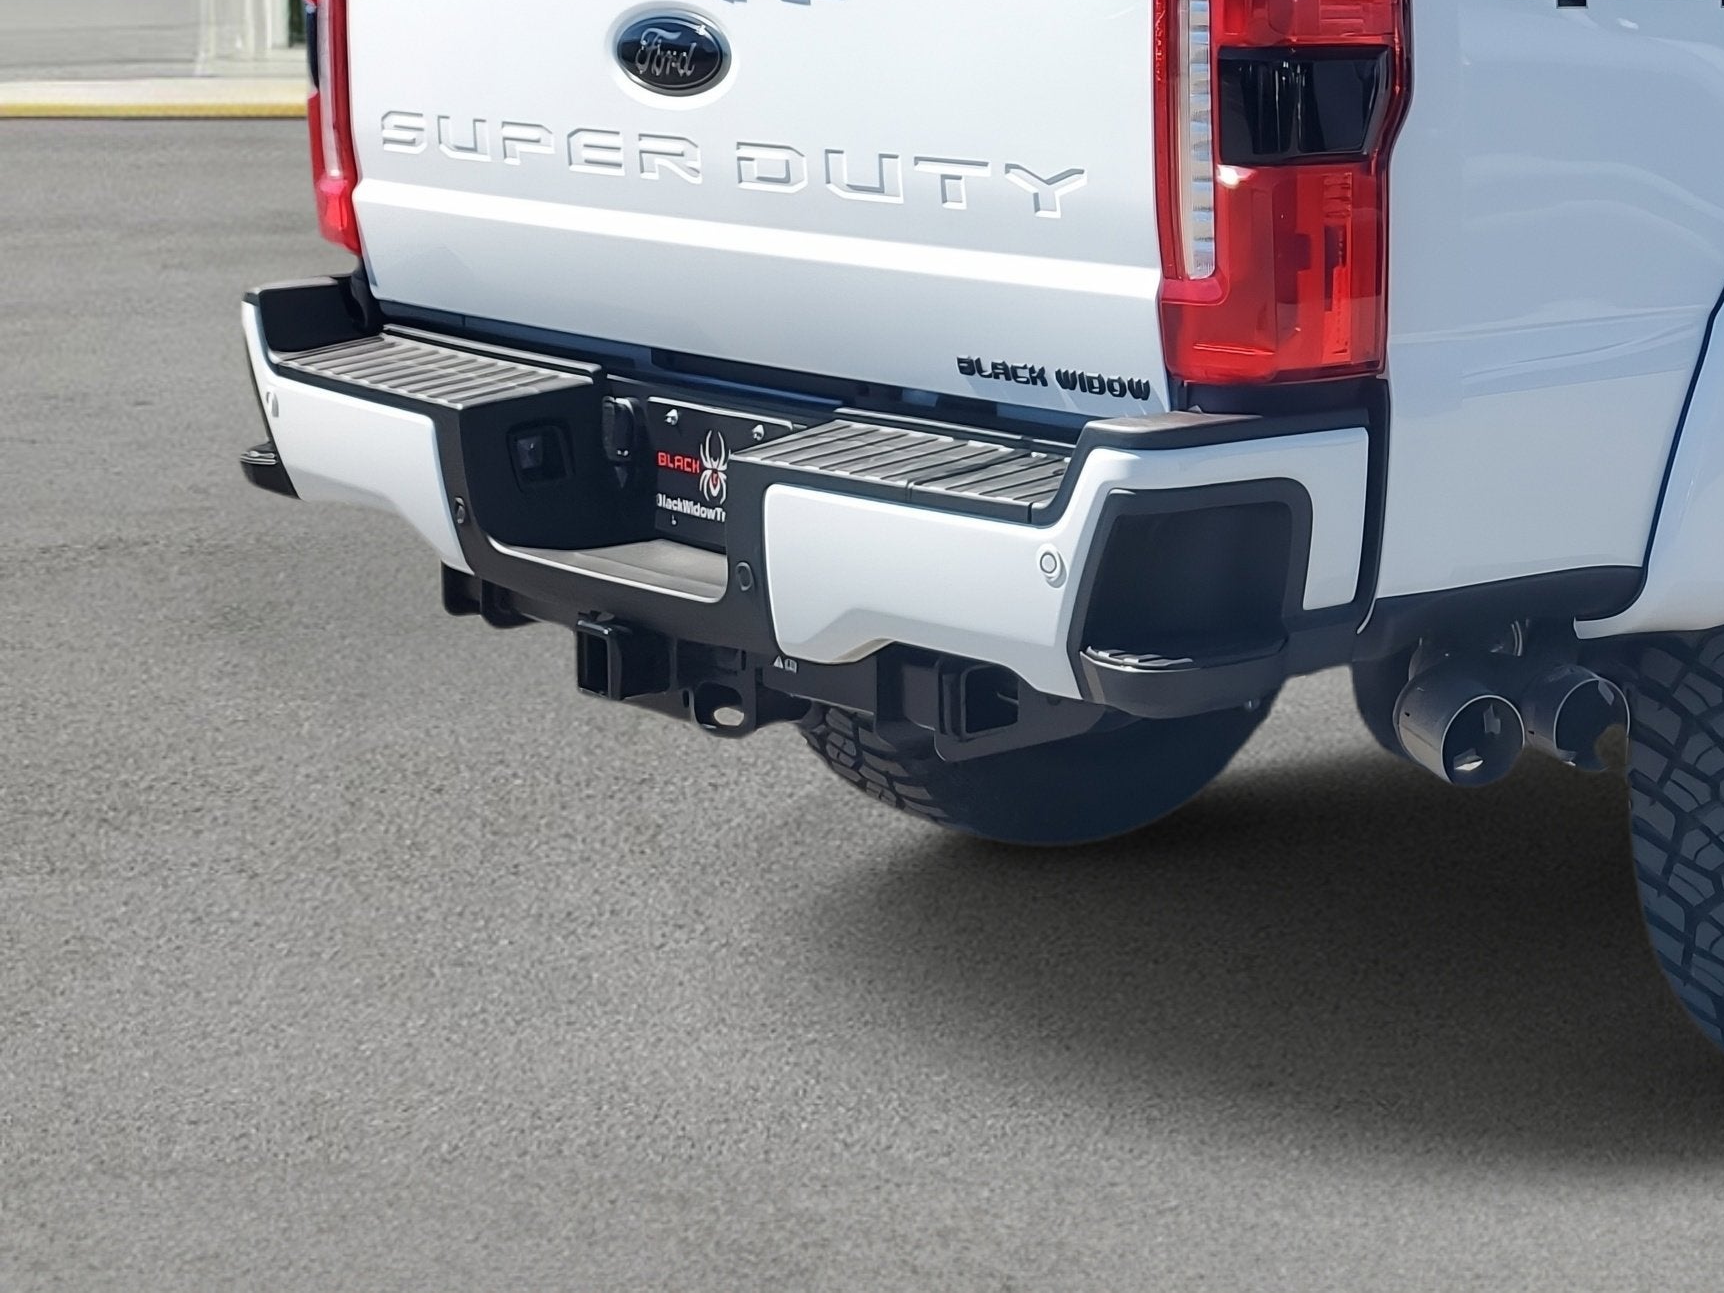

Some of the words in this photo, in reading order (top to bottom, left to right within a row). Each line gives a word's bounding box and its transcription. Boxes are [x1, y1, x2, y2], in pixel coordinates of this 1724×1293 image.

[635, 27, 697, 77] Ford
[381, 109, 703, 184] SUPER
[736, 141, 1088, 219] DUTY
[956, 355, 1048, 387] BLACK
[1054, 368, 1151, 401] WIDOW
[658, 452, 700, 473] BLACK
